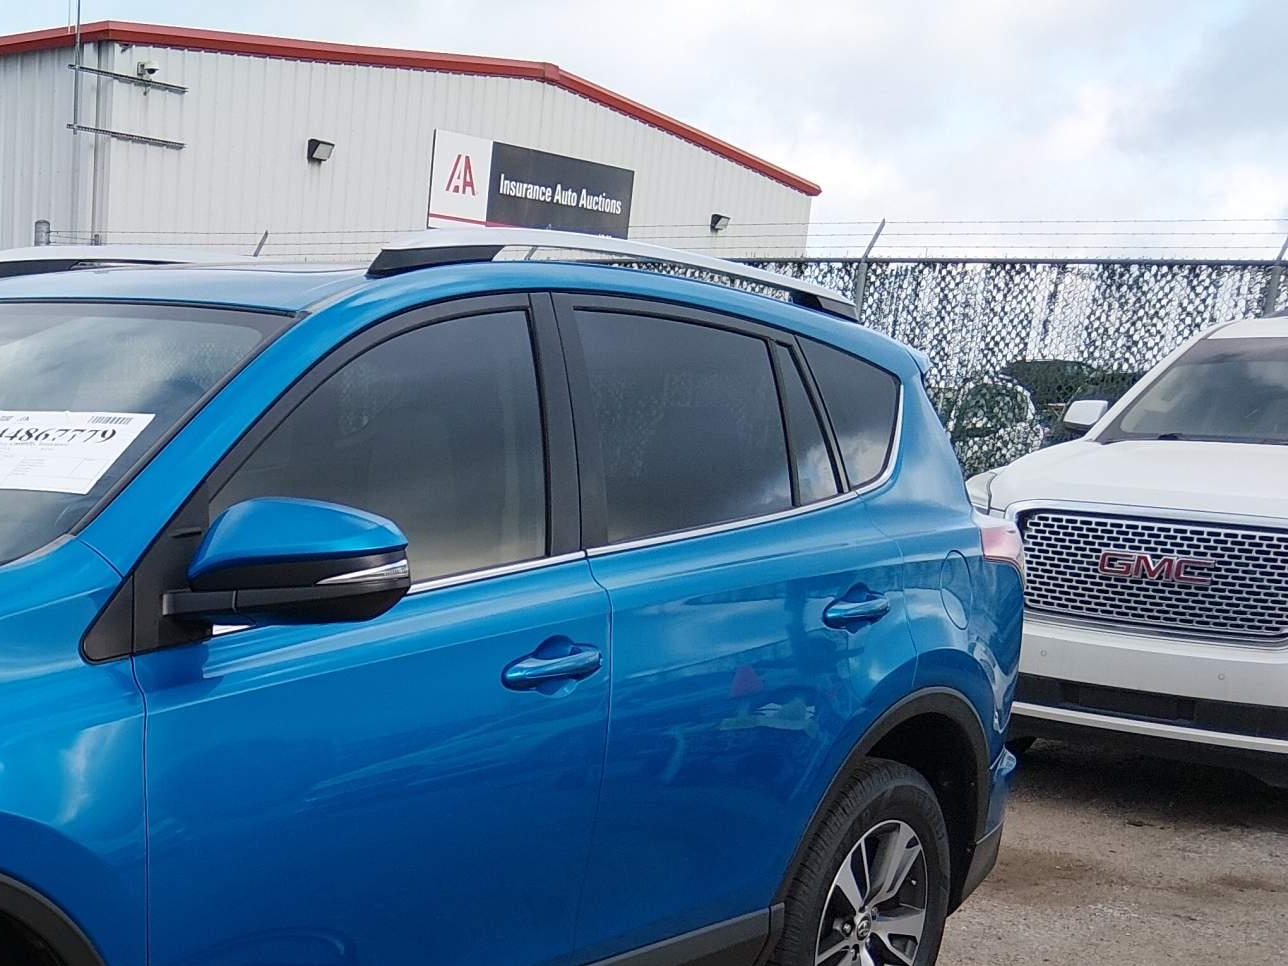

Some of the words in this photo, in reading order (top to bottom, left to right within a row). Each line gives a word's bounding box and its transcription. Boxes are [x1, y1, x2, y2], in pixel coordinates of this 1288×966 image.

[499, 173, 552, 202] Insurance
[553, 183, 578, 206] Auto
[578, 188, 622, 215] Auctions
[1098, 550, 1216, 586] GMC
